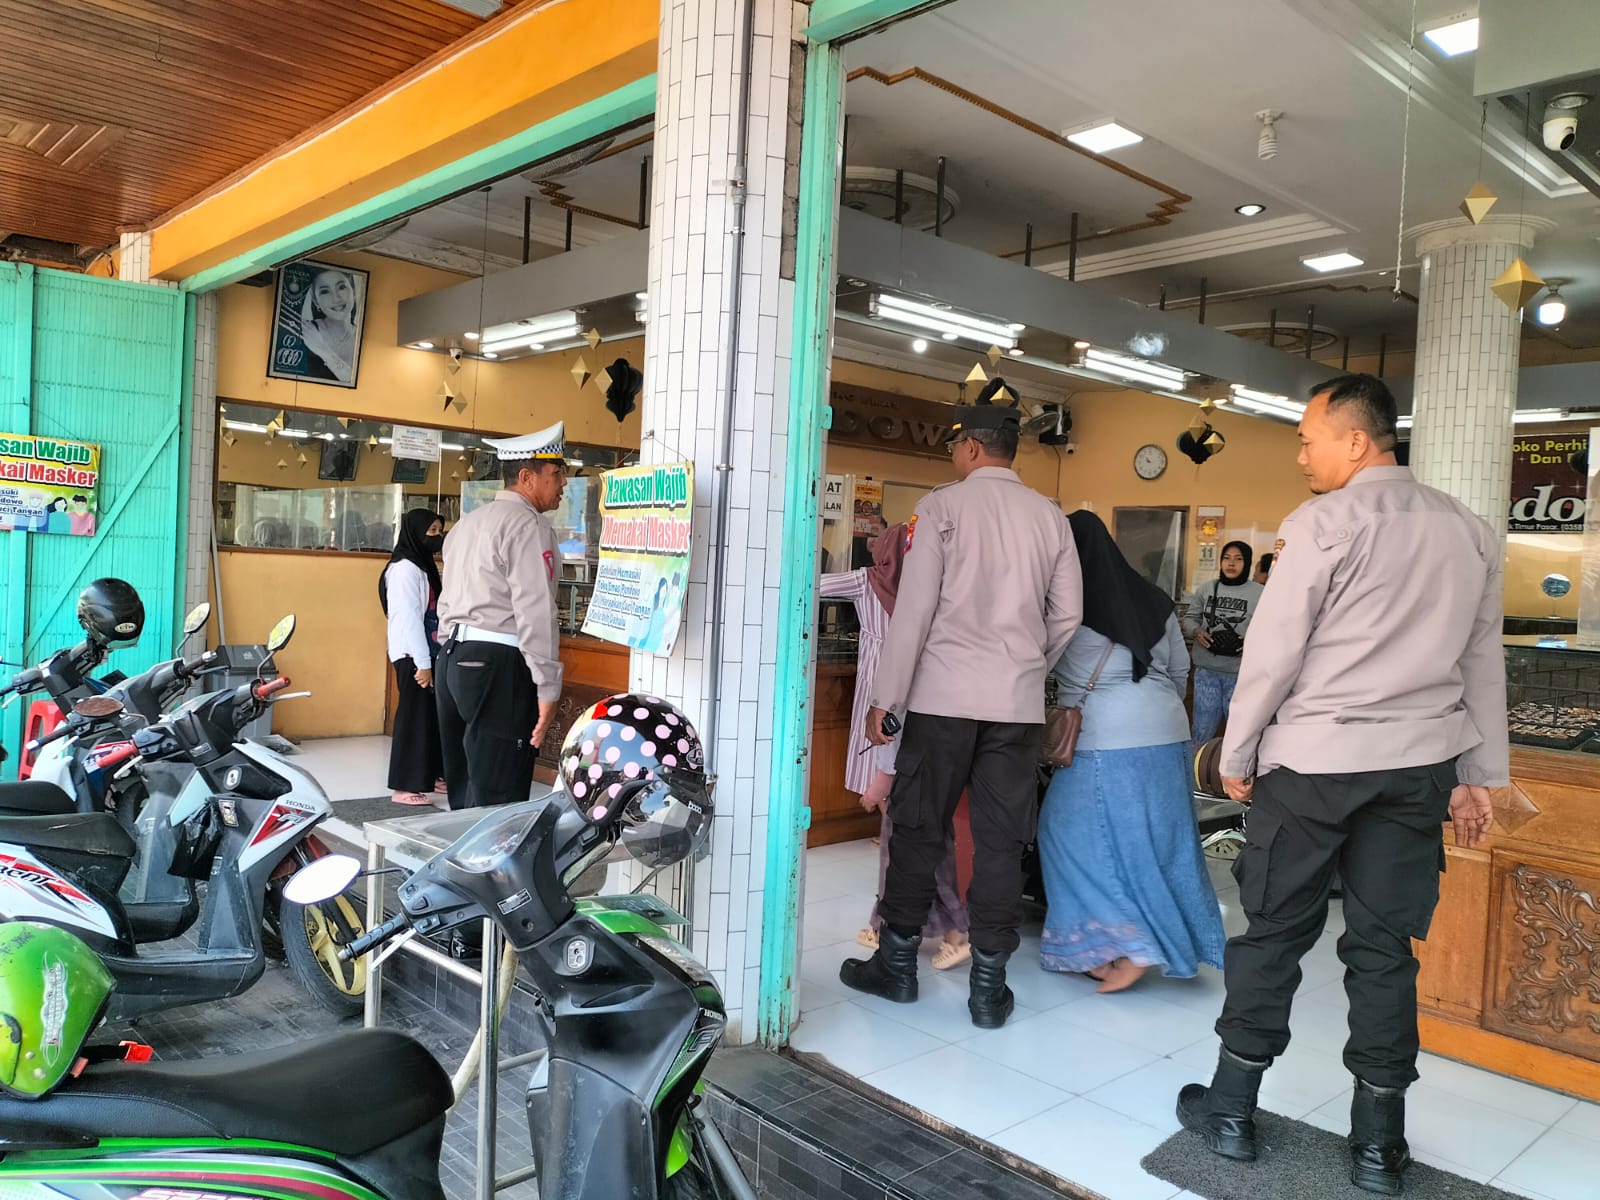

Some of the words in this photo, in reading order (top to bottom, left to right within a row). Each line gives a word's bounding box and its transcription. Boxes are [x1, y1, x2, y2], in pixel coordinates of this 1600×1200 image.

[38, 440, 91, 463] Wajib
[1530, 453, 1562, 464] Dan
[28, 463, 96, 486] Masker
[606, 474, 653, 503] Kawasan
[655, 467, 687, 504] Wajib
[825, 482, 842, 492] AT
[13, 507, 43, 516] Tangan
[602, 517, 647, 548] Memakai
[649, 517, 690, 550] Masker
[286, 799, 316, 811] HONDA
